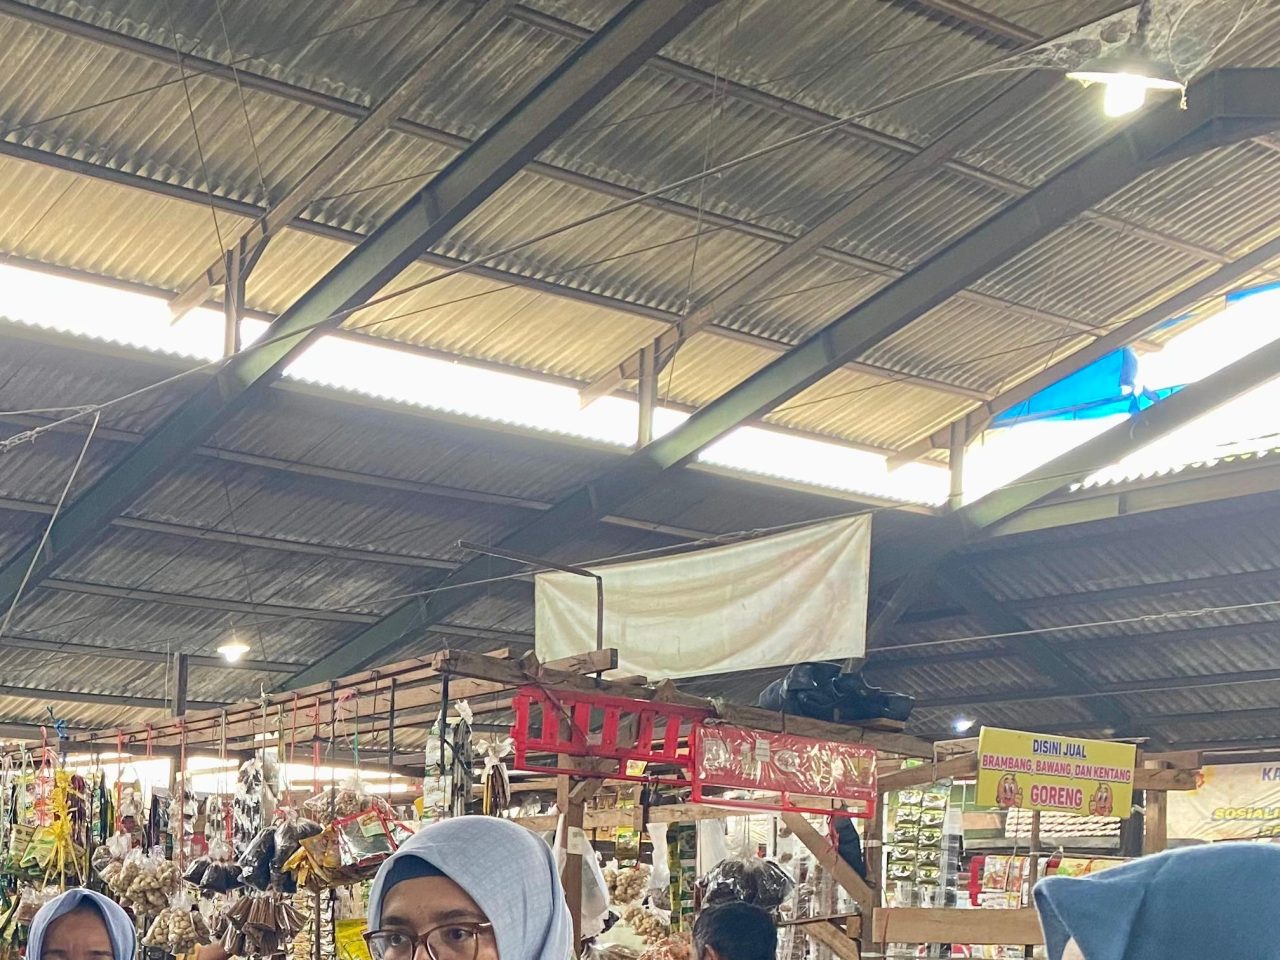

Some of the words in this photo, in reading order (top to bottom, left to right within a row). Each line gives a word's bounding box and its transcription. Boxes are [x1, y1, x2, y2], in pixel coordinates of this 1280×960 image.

[1033, 739, 1063, 756] DISINI
[1063, 744, 1087, 758] JUAL
[982, 754, 1034, 773] BRAMBANG,
[1035, 760, 1073, 777] BAWANG,
[1075, 766, 1092, 777] DAN
[1093, 767, 1131, 781] KENTANG
[1031, 785, 1083, 808] GORENG
